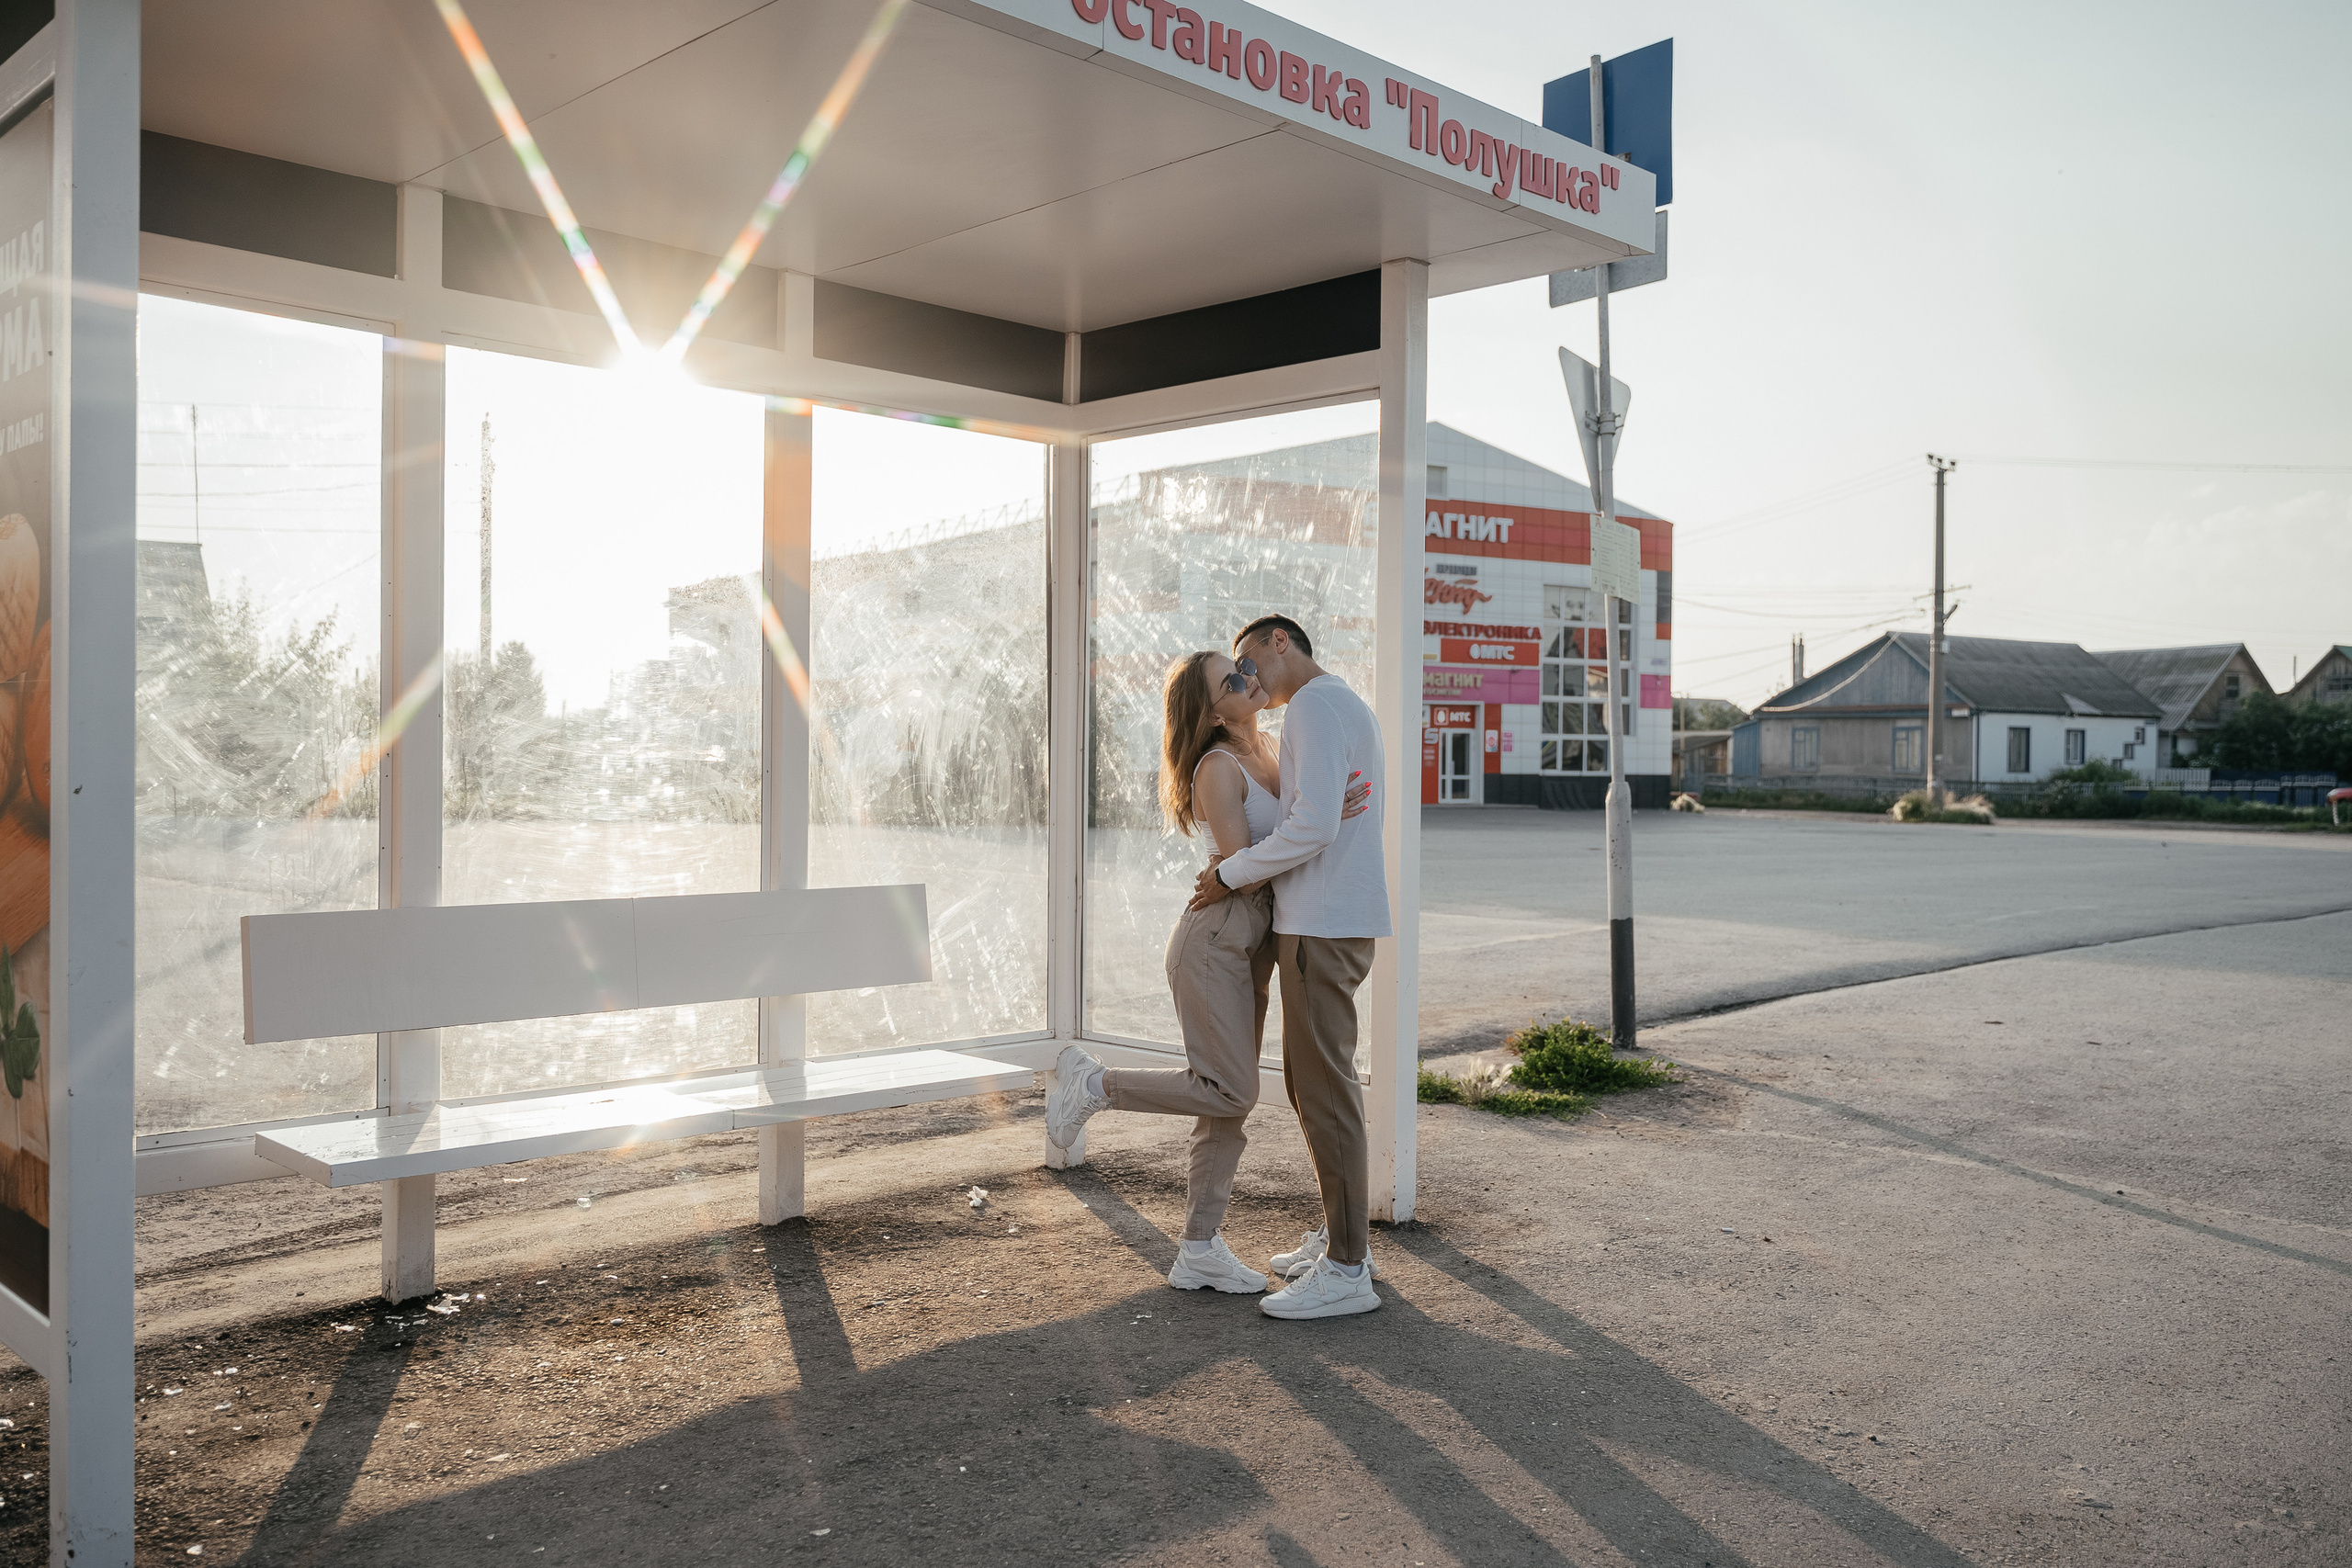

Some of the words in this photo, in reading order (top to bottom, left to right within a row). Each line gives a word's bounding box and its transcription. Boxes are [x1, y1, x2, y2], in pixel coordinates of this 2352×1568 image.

[1385, 77, 1621, 215] "Полушка"
[0, 296, 44, 383] МА
[1425, 511, 1514, 544] АГНИТ
[1480, 645, 1515, 660] МТС
[1450, 711, 1472, 723] МТС
